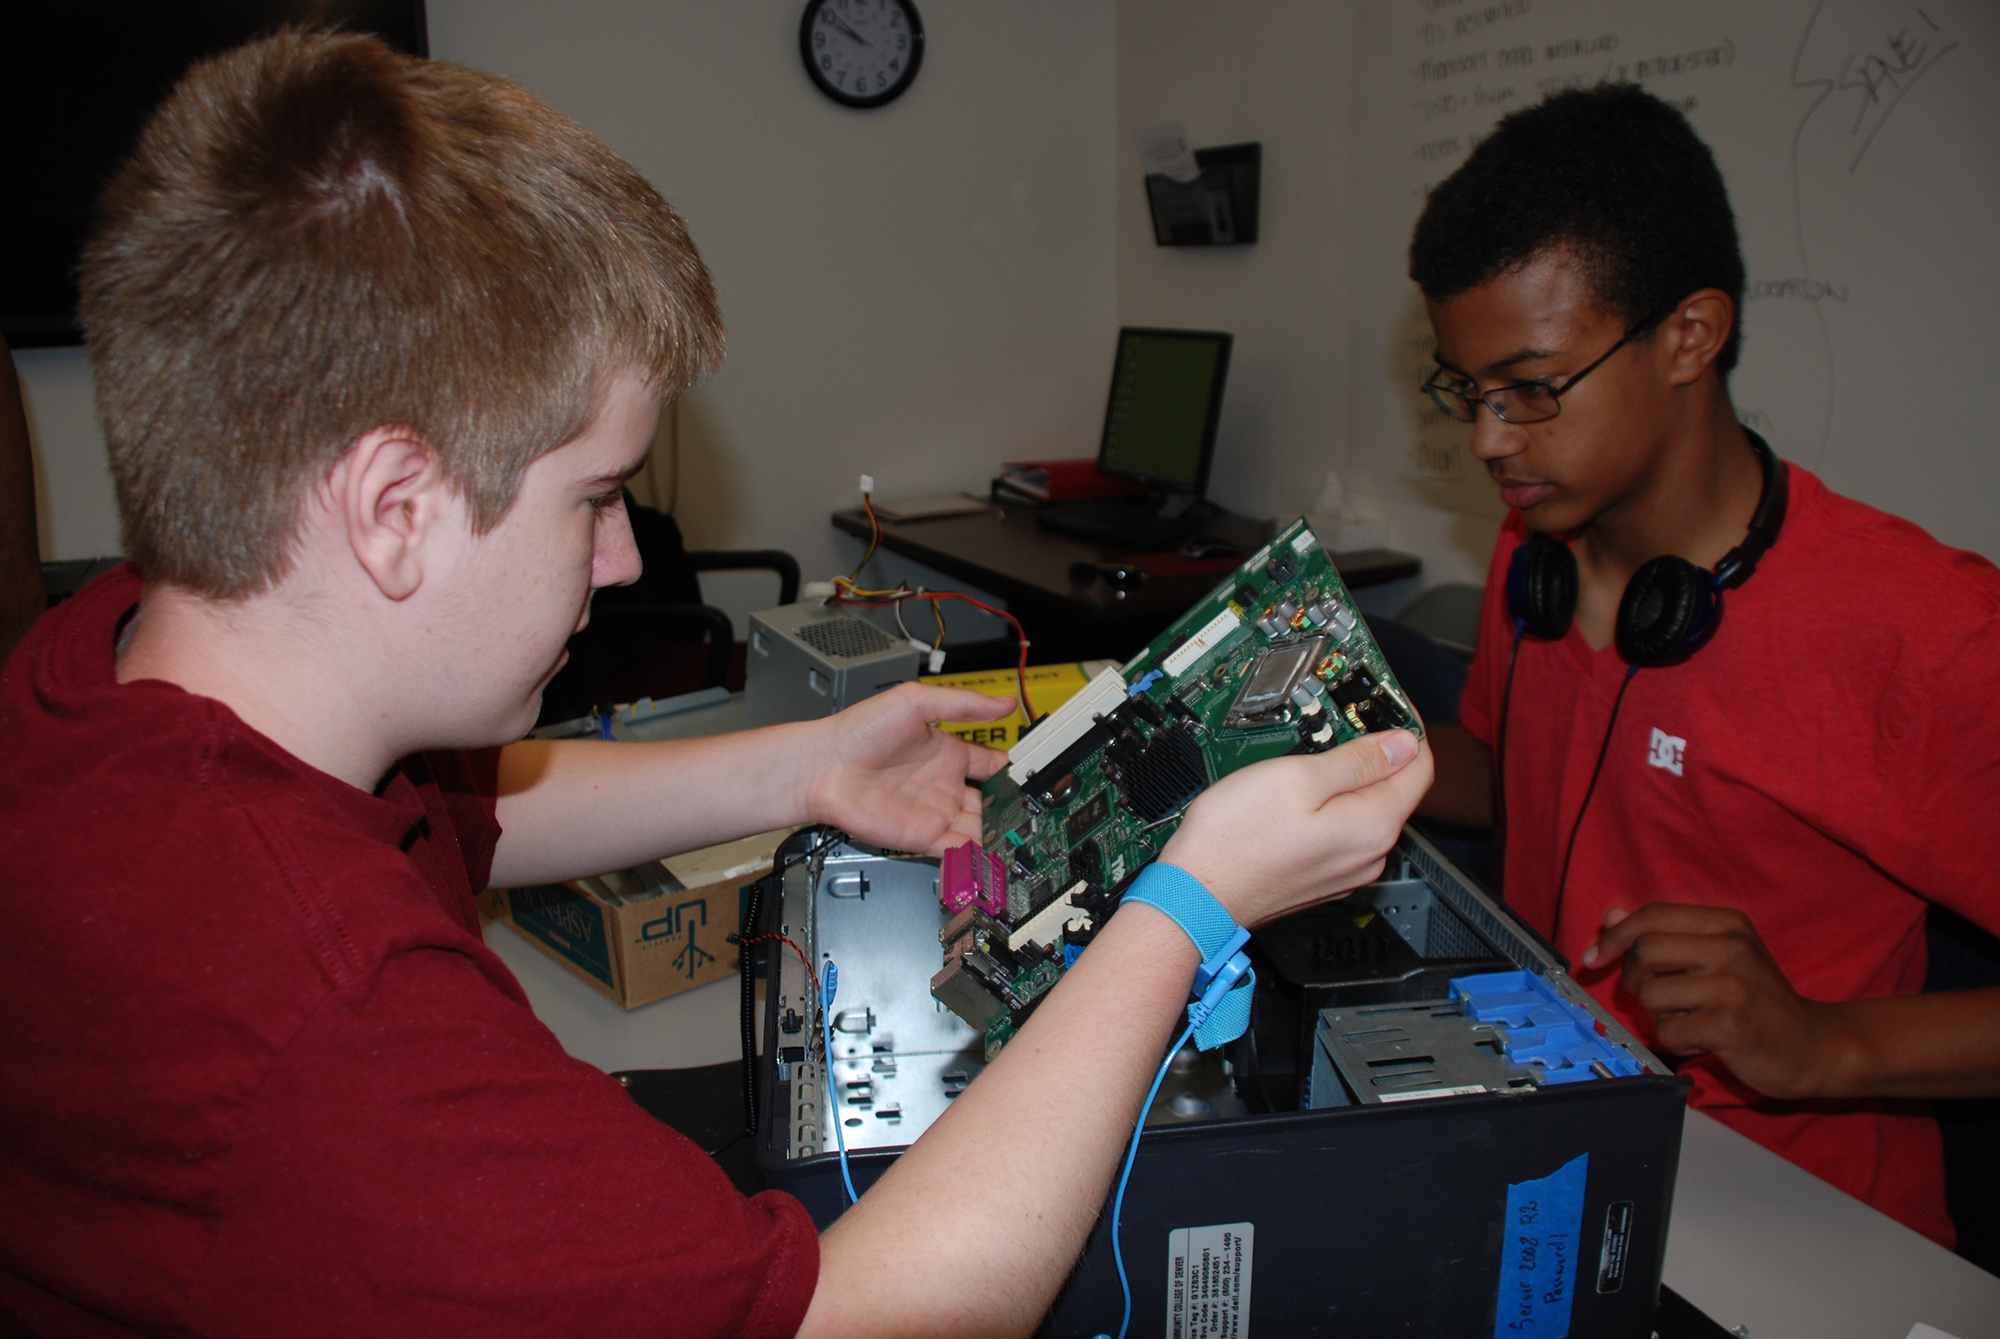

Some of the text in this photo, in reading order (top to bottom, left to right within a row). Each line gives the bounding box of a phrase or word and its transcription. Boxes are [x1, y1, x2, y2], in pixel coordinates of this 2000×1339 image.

[821, 7, 836, 24] 10
[891, 10, 901, 28] 2
[815, 31, 826, 48] 9
[897, 33, 907, 50] 3
[821, 53, 832, 70] 8
[836, 70, 847, 86] 7
[856, 76, 867, 92] 6
[877, 70, 887, 88] 5
[1175, 1256, 1185, 1279] DENVER
[1201, 1247, 1211, 1299] 34949080801
[1509, 1200, 1539, 1331] Server 2008 R2
[1175, 1280, 1184, 1288] OF
[1222, 1277, 1232, 1297] (800)
[1174, 1288, 1184, 1312] COLLEGE
[1190, 1313, 1199, 1326] Tag
[1200, 1301, 1209, 1324] Code:
[1210, 1311, 1219, 1332] Order
[1220, 1309, 1230, 1339] Support
